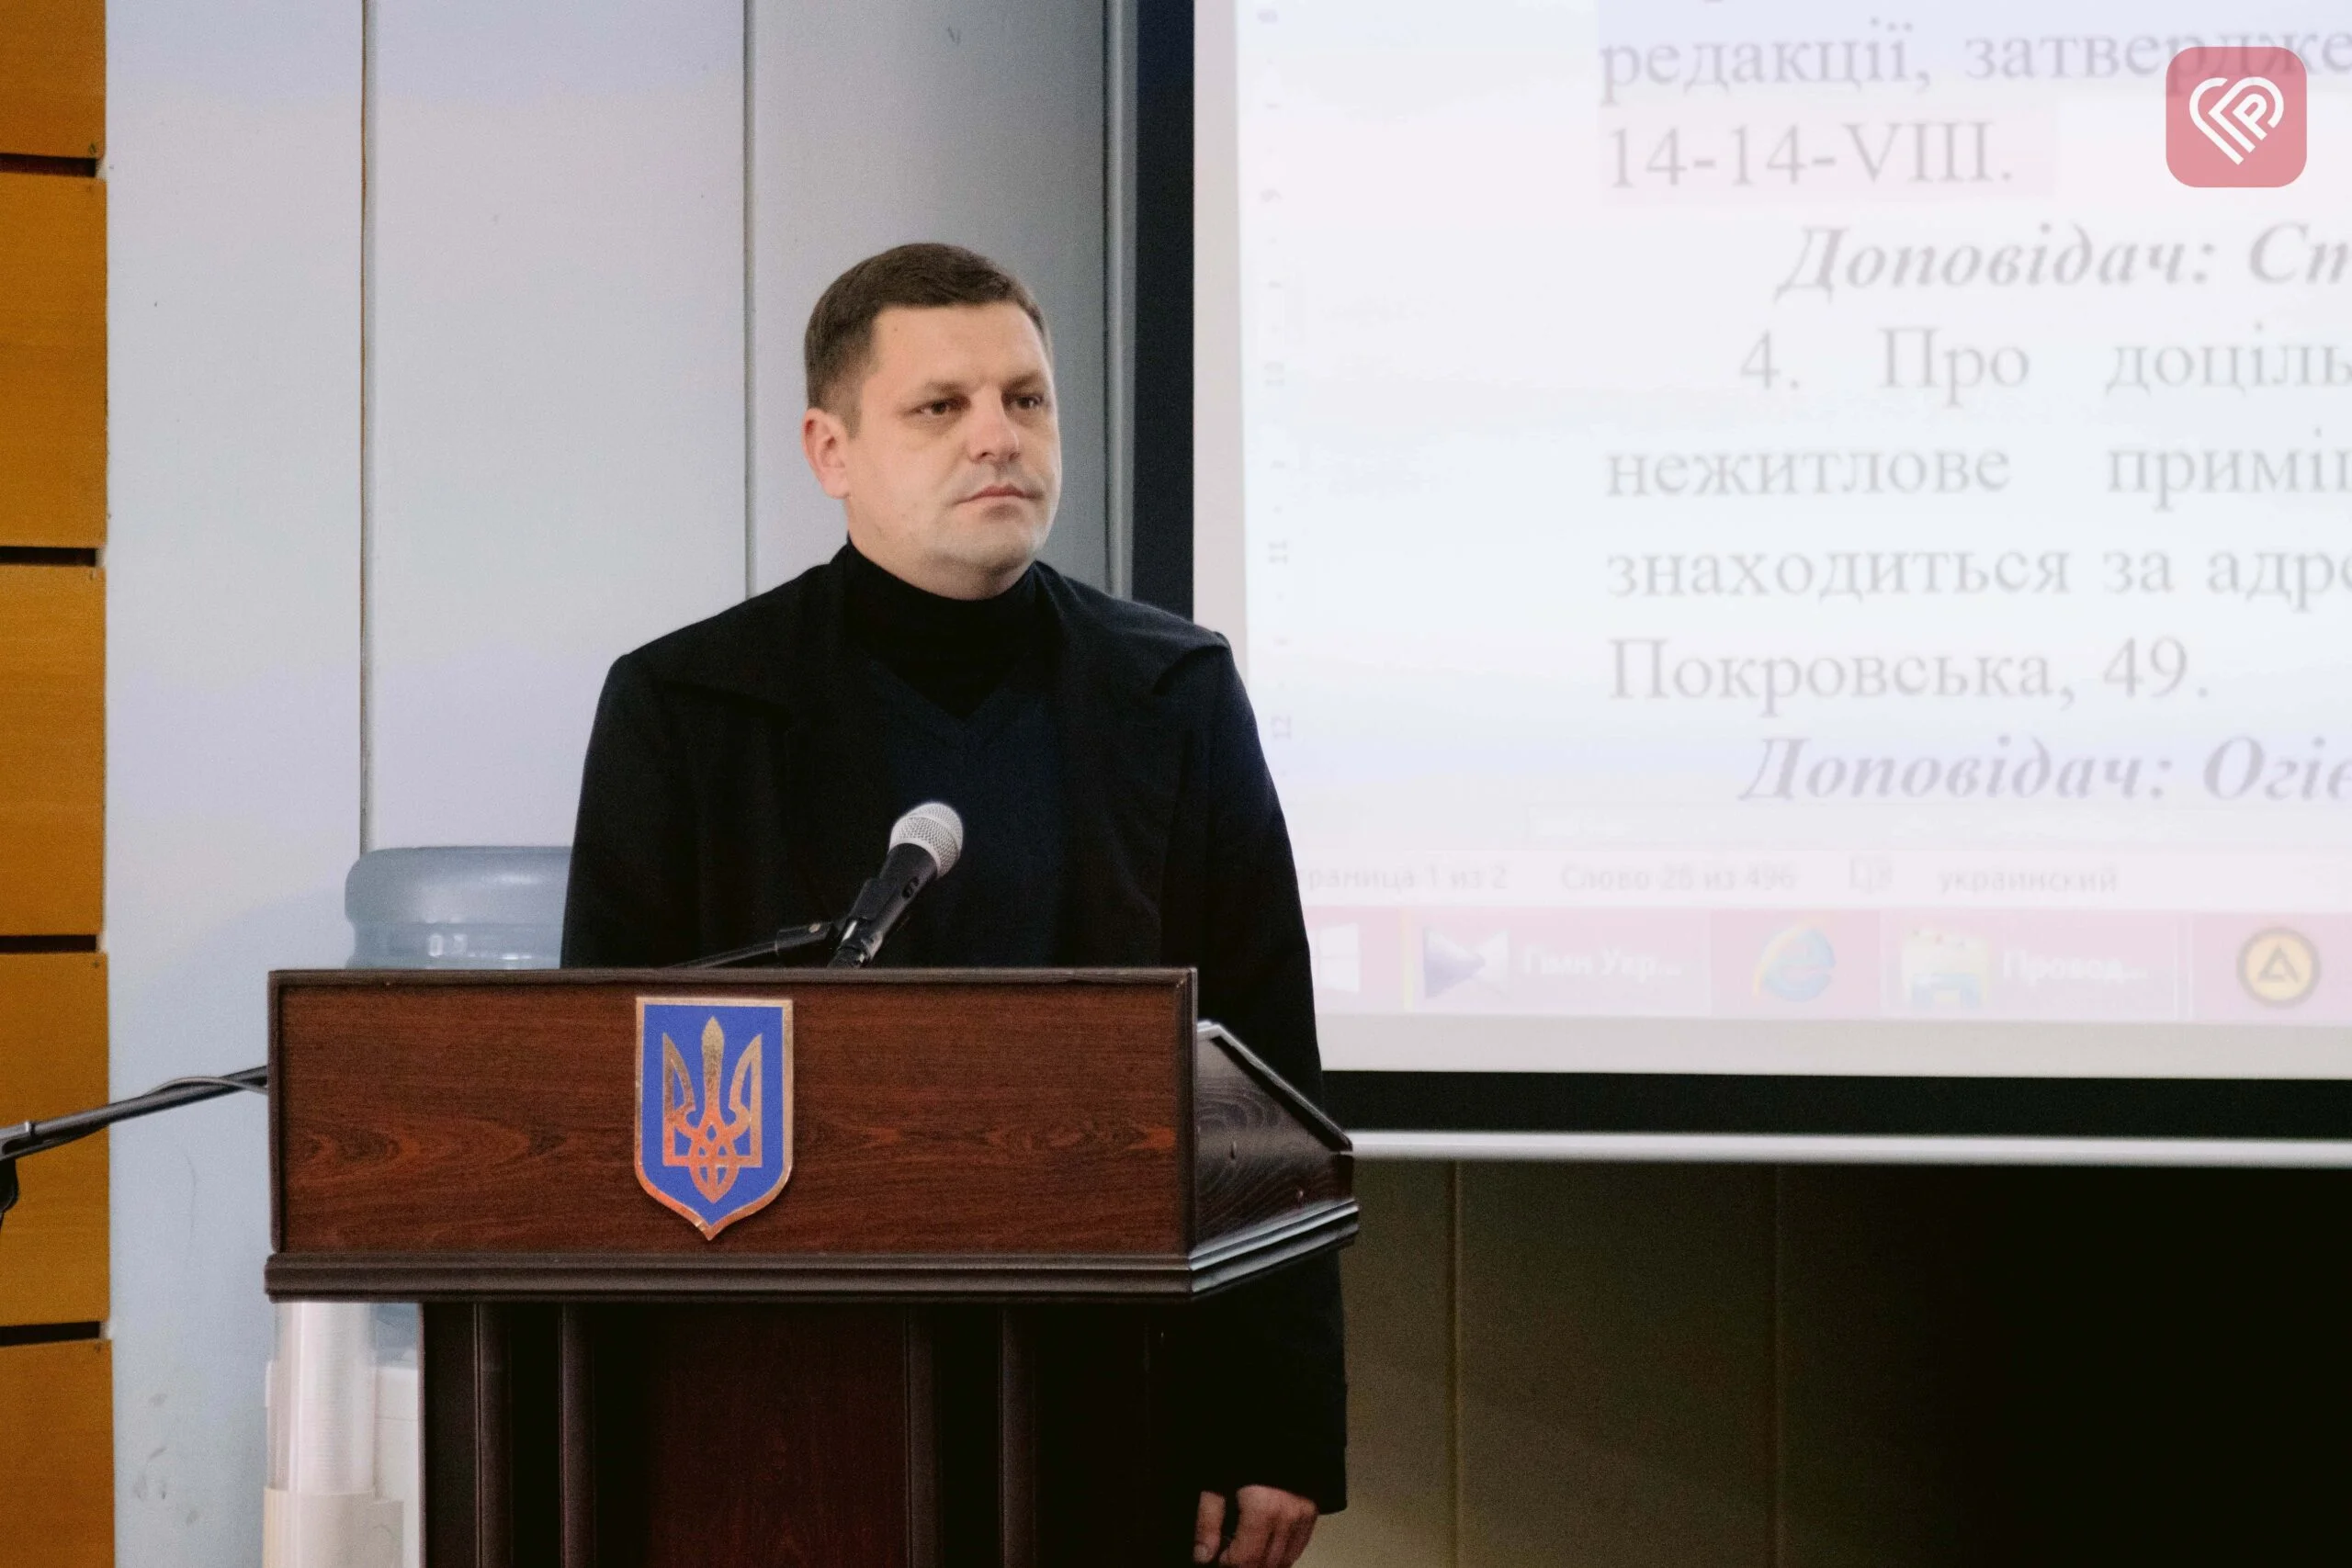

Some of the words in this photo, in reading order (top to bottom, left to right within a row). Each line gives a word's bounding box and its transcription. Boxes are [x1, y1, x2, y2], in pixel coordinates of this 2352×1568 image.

[1600, 17, 1931, 107] редакції,
[1609, 119, 2013, 188] 14-14-VIII.
[1772, 220, 2217, 305] Доповідач:
[1740, 327, 1801, 392] 4.
[1877, 325, 2031, 409] Про
[1603, 446, 2012, 498] нежитлове
[1606, 548, 2073, 605] знаходиться
[2102, 548, 2175, 595] за
[1606, 637, 2076, 718] Покровська,
[2101, 634, 2210, 700] 49.
[1736, 733, 2173, 803] Доповідач:
